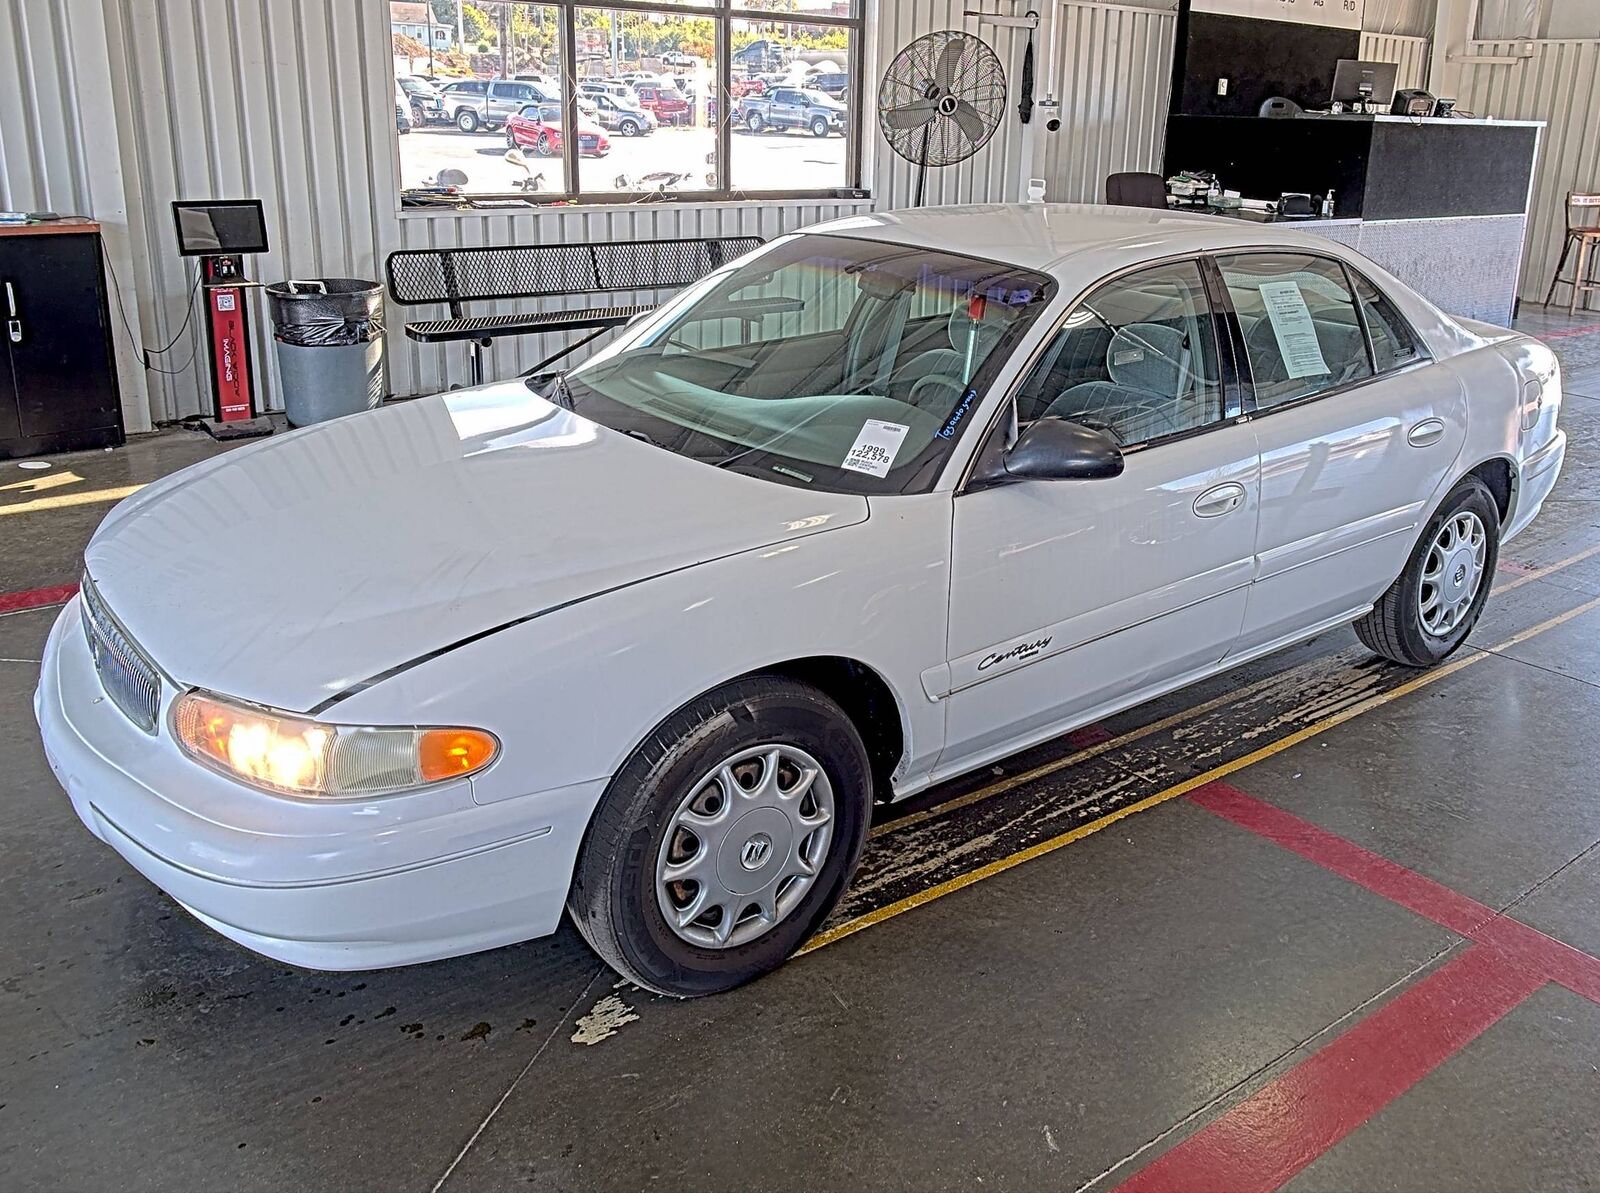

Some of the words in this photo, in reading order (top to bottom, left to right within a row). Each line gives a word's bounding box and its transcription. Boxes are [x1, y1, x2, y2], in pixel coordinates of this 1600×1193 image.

[851, 449, 890, 464] 122,578
[862, 444, 886, 455] 1999
[977, 636, 1053, 671] Century
